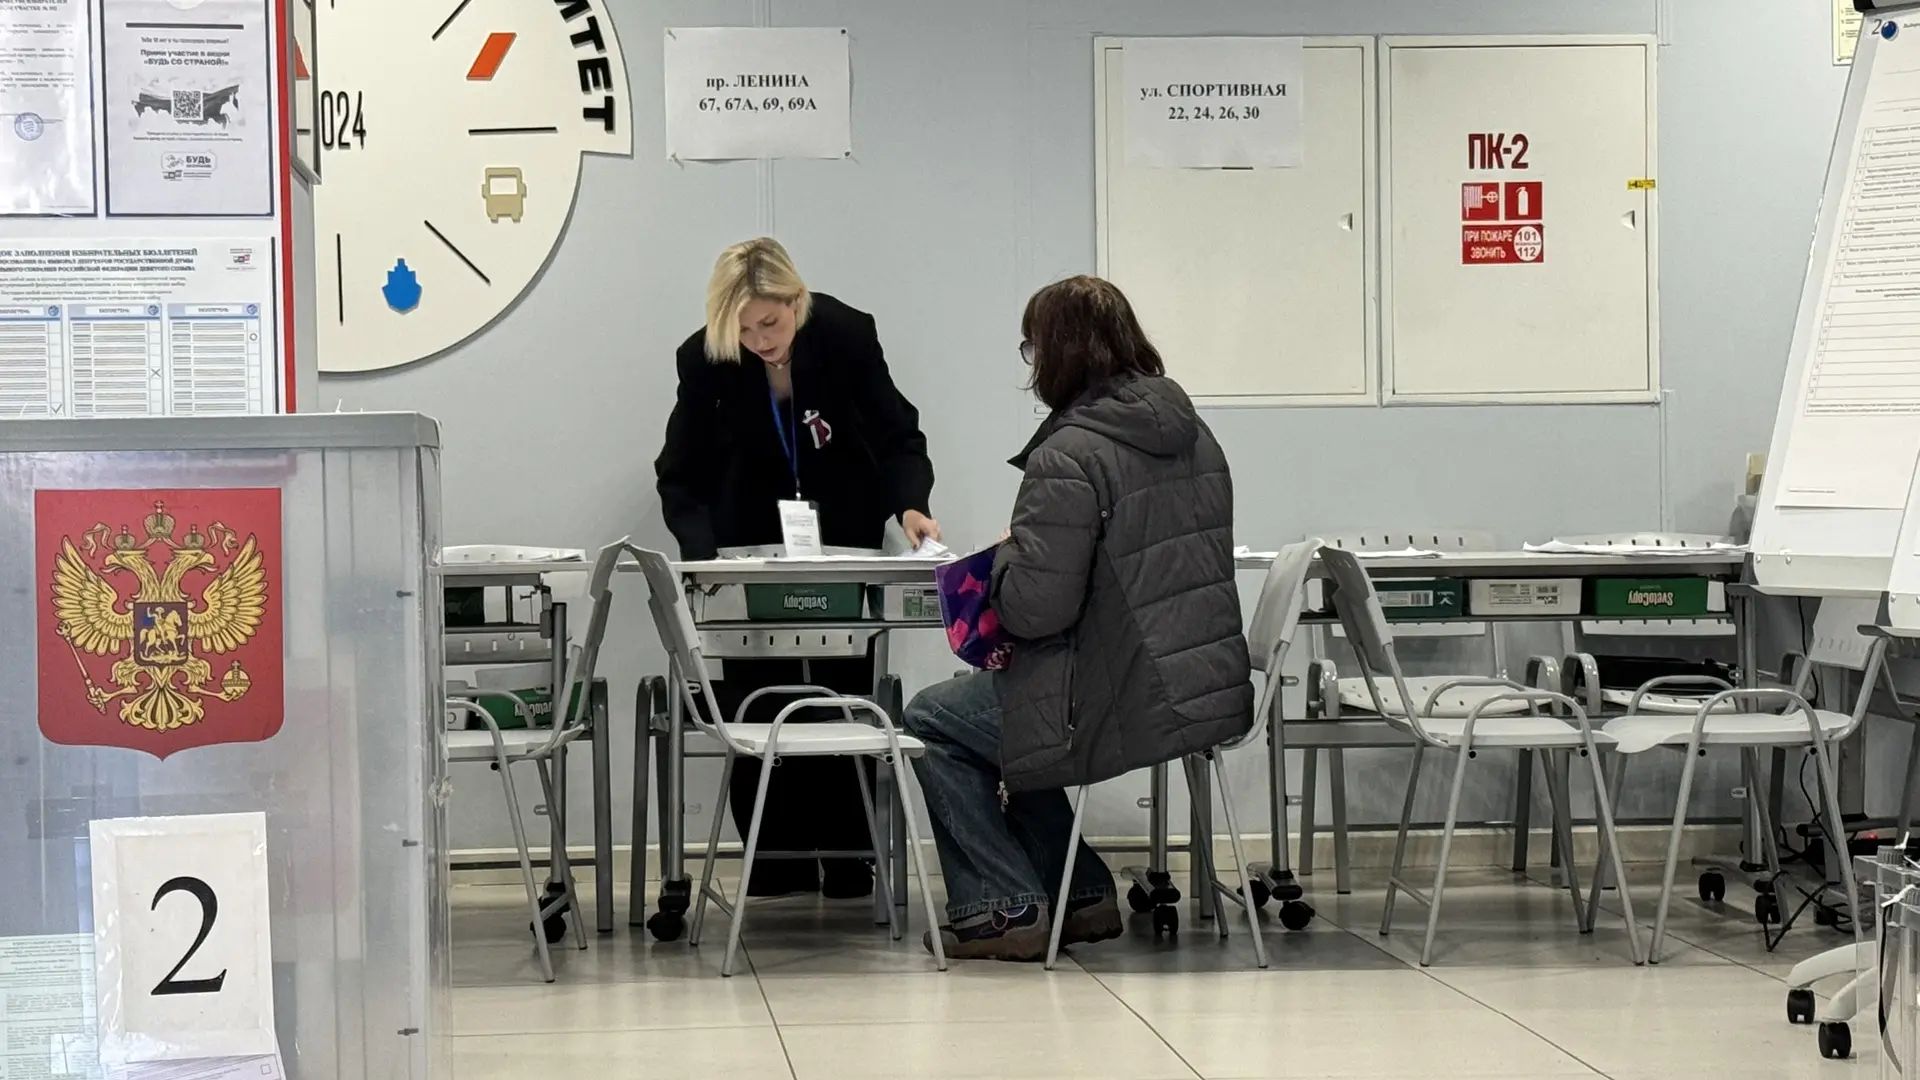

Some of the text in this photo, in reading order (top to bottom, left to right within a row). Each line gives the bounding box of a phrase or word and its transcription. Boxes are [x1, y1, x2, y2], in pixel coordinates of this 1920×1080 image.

[1871, 18, 1883, 35] 2
[140, 49, 167, 57] Прими
[168, 50, 199, 58] участие
[706, 74, 809, 91] пр. ЛЕНИНА
[1140, 83, 1287, 100] ул. СПОРТИВНАЯ
[699, 97, 817, 113] 67, 67А, 69, 69А
[1168, 106, 1260, 121] 22, 24, 26, 30
[1468, 133, 1529, 169] ПК-2
[186, 155, 211, 164] БУДЬ
[1464, 229, 1513, 242] ПРИ ПОЖАРЕ
[1518, 231, 1537, 241] 101
[1470, 246, 1507, 259] ЗВОНИТЬ
[1518, 246, 1537, 257] 112
[783, 594, 828, 610] SvetoCopy
[1627, 590, 1674, 607] SvetoCopy
[151, 876, 228, 996] 2
